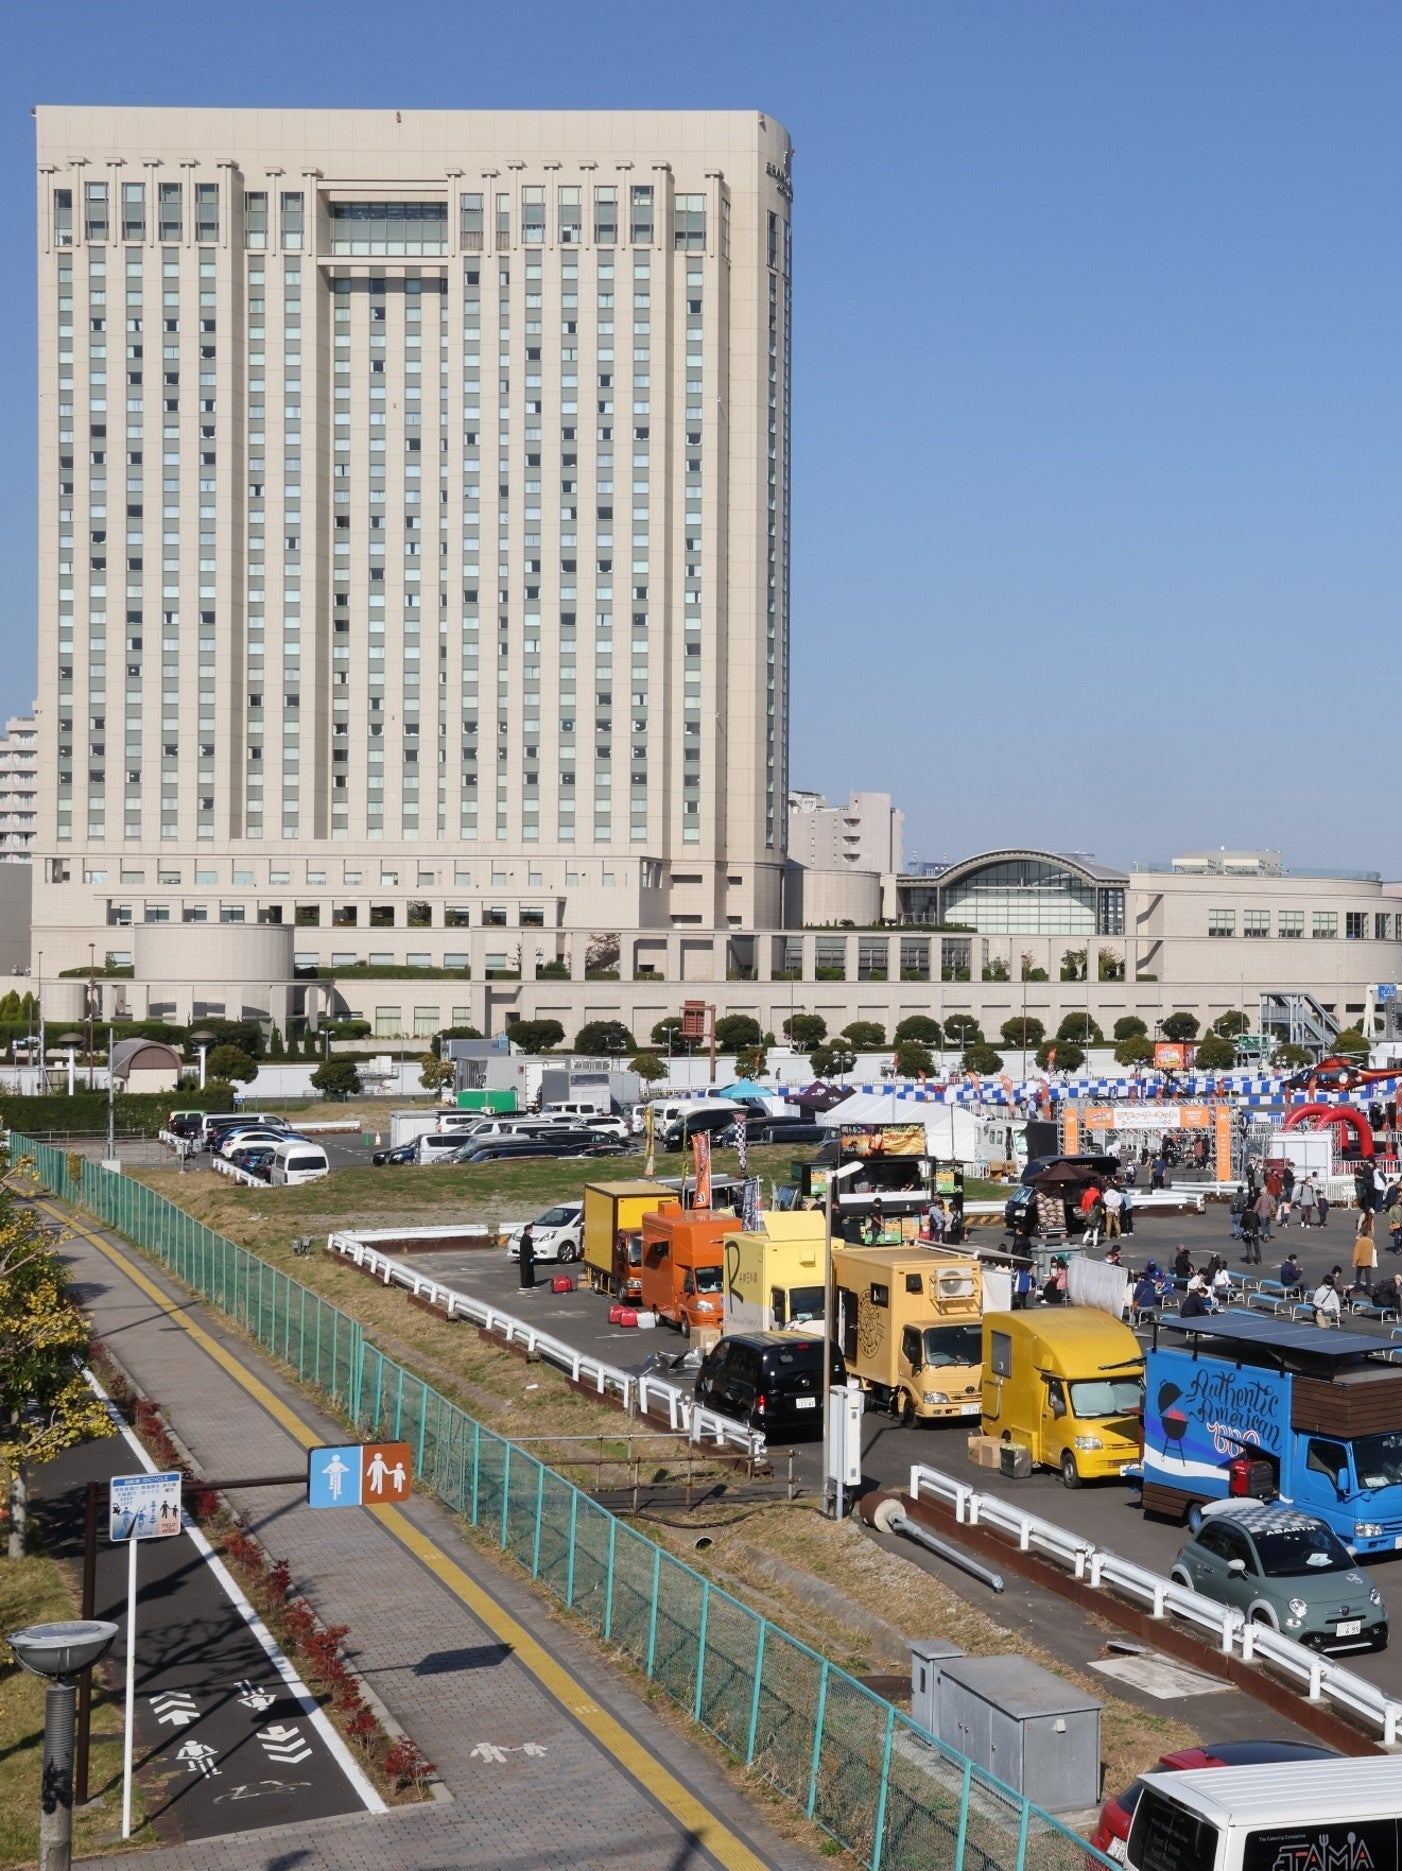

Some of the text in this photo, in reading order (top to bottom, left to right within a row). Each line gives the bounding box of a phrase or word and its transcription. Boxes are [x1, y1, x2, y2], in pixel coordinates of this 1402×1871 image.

[1185, 1369, 1279, 1418] Authentic
[1185, 1397, 1282, 1451] American
[1266, 1525, 1316, 1536] ABARTH
